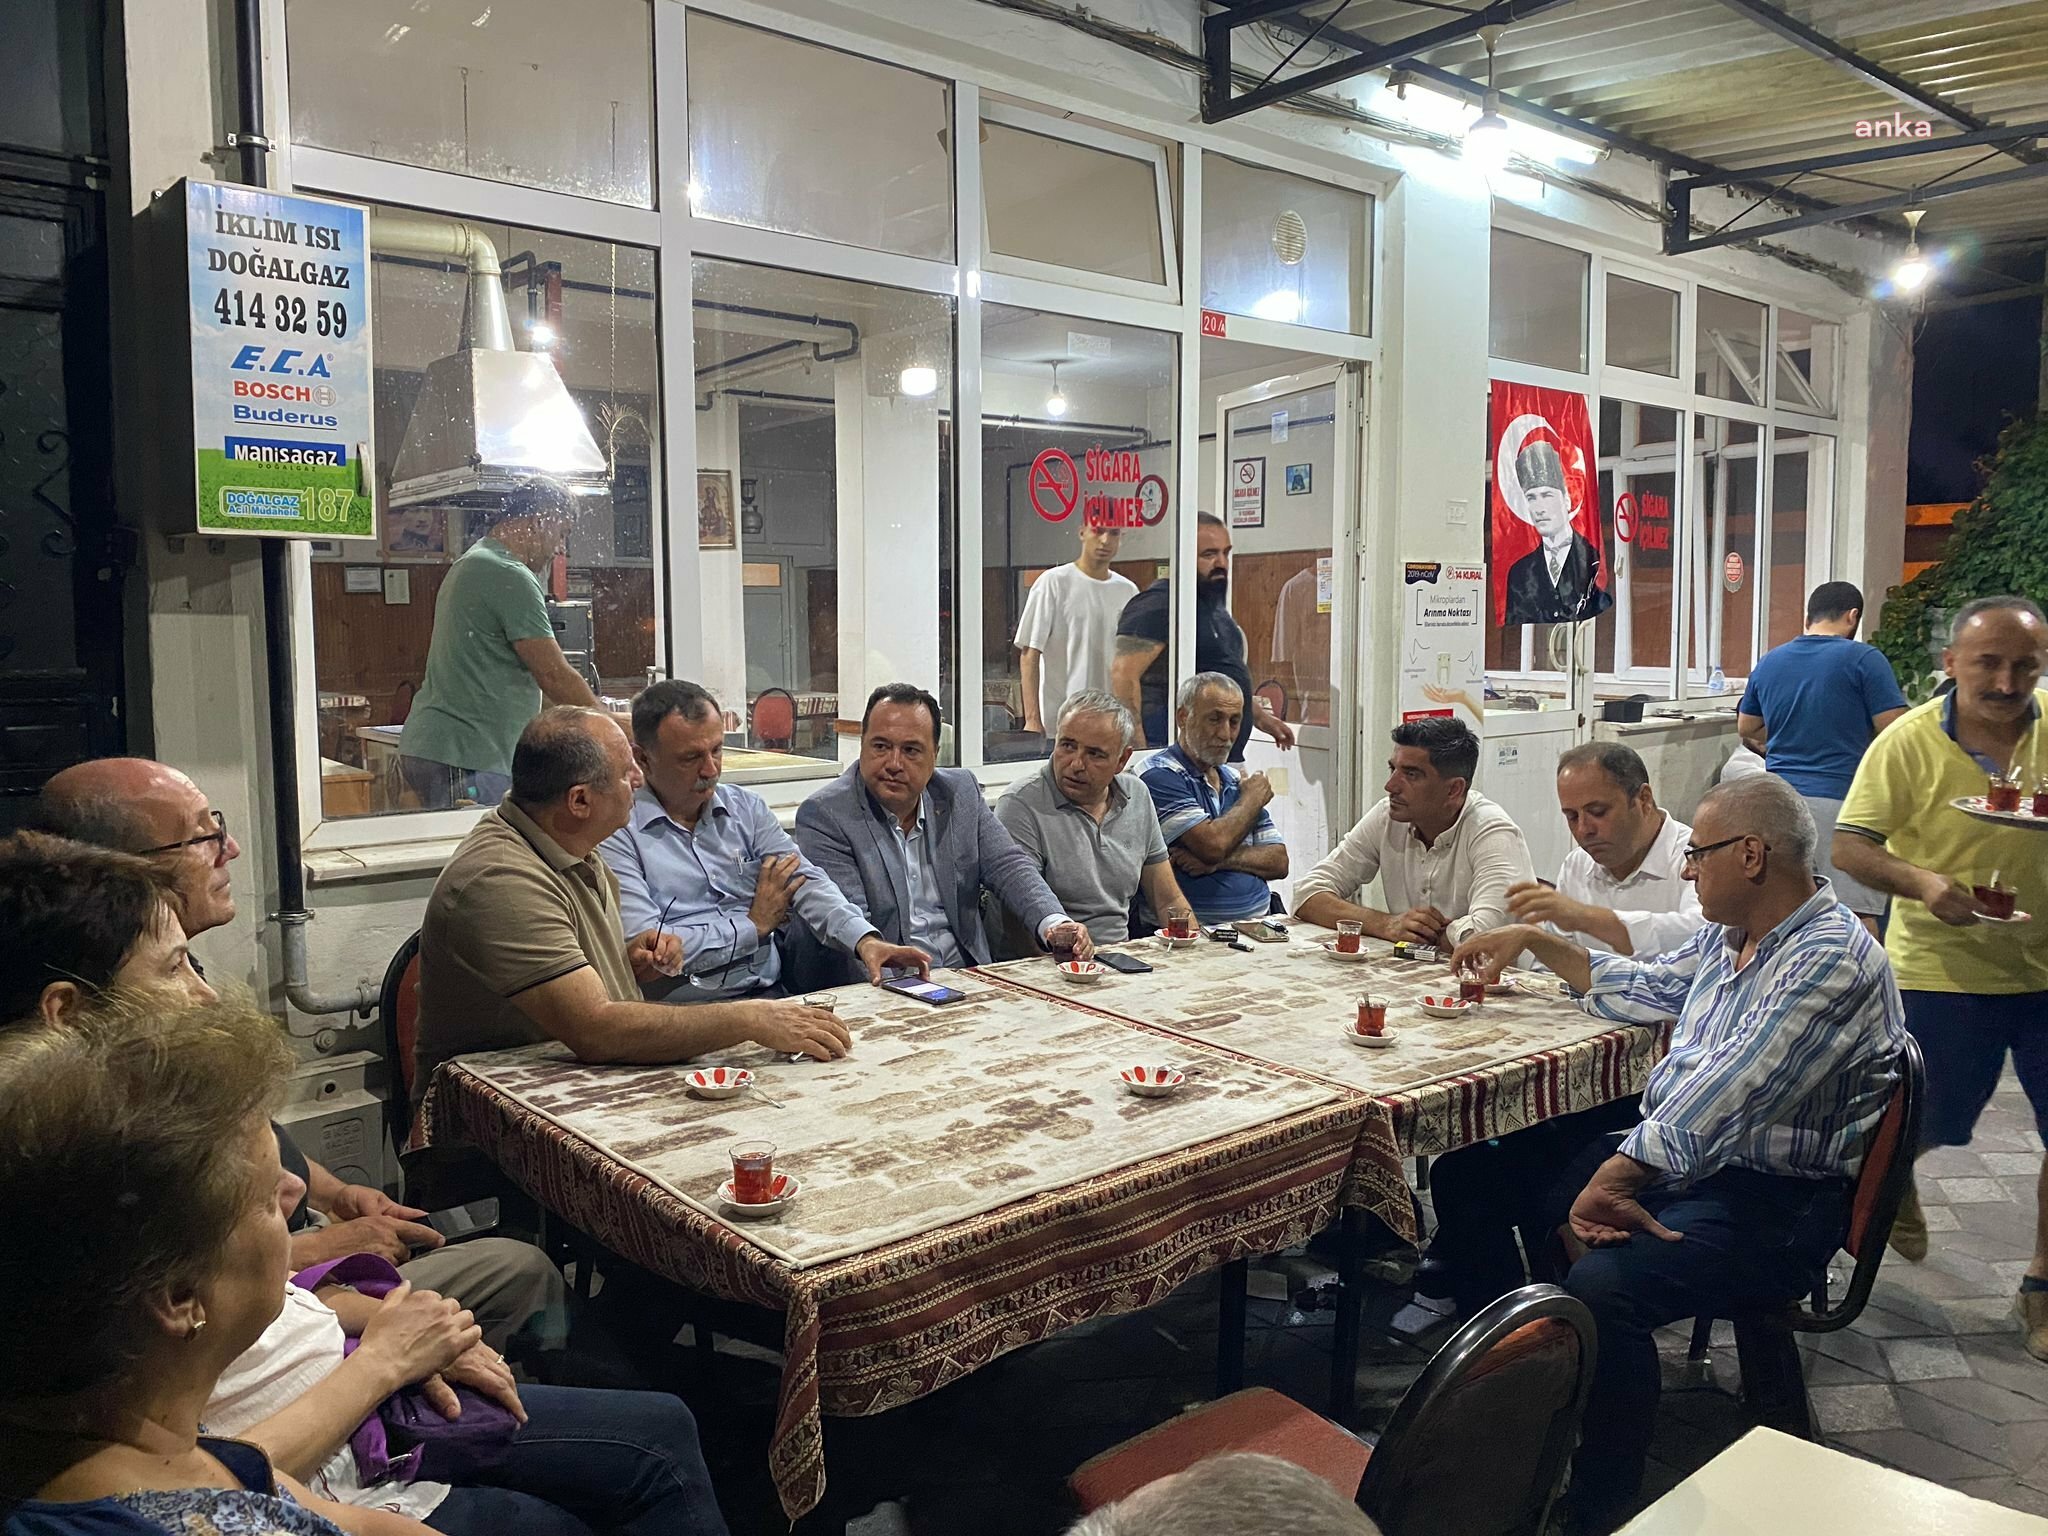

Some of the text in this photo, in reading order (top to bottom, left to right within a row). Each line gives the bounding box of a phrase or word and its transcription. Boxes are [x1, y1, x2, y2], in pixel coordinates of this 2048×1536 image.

[215, 203, 341, 251] İKLİM ISI
[207, 246, 350, 290] DOĞALGAZ
[214, 288, 348, 339] 414 32 59
[233, 380, 311, 402] BOSCH
[233, 404, 338, 427] Buderus
[257, 462, 317, 472] DOĞALGAZ
[1085, 443, 1142, 483] SİGARA
[227, 491, 300, 507] DOĞALGAZ
[228, 505, 249, 515] Acil
[300, 486, 355, 522] 187
[1083, 490, 1145, 533] İÇİLMEZ
[1455, 570, 1483, 580] 14 KURAL
[1429, 594, 1466, 605] Mikroplardan
[1424, 607, 1472, 618] Arınma Noktası
